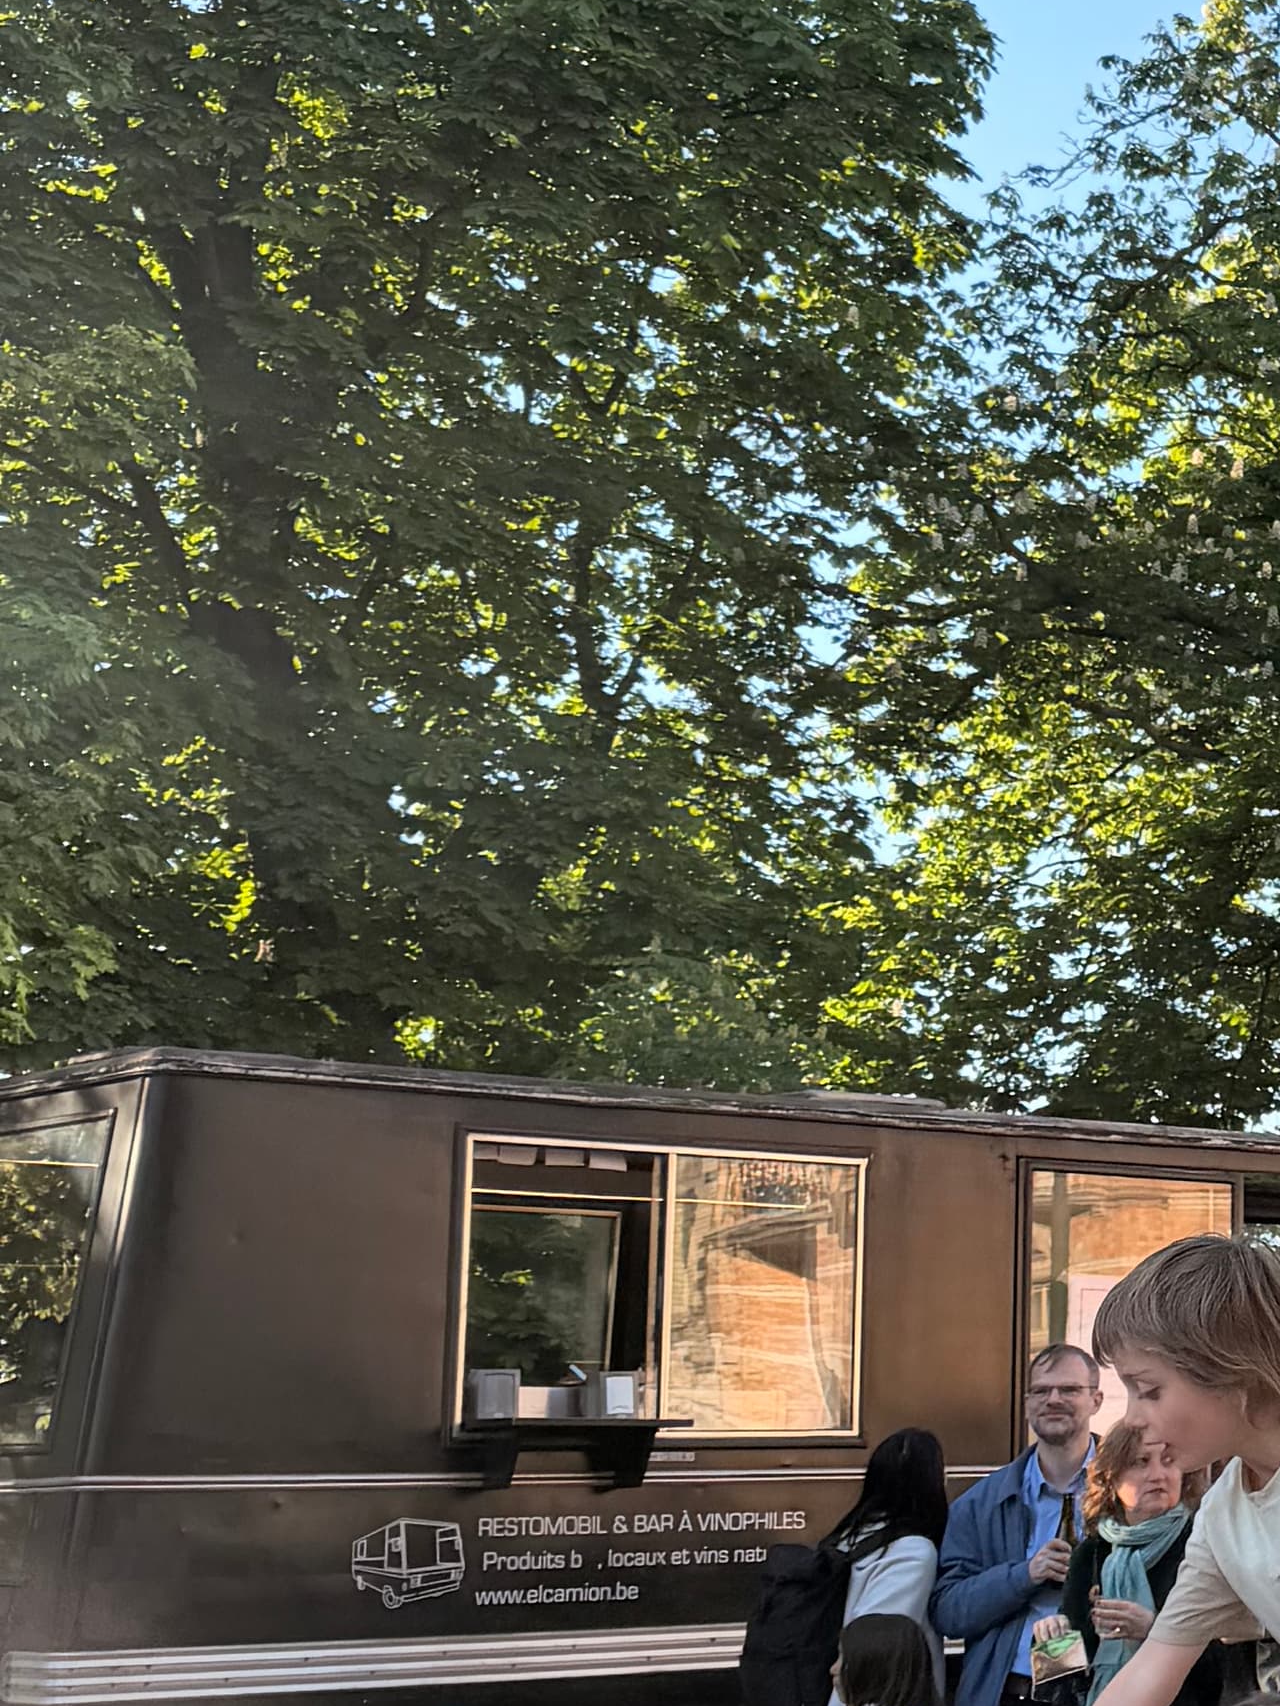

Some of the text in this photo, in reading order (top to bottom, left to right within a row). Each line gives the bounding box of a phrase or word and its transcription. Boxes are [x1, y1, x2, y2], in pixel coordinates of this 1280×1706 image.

[478, 1509, 806, 1537] RESTOMOBIL & BAR À VINOPHILES
[483, 1550, 566, 1571] Produits
[607, 1548, 666, 1568] locaux
[671, 1548, 691, 1565] et
[694, 1546, 729, 1565] vins
[475, 1580, 639, 1606] www.elcamion.be
